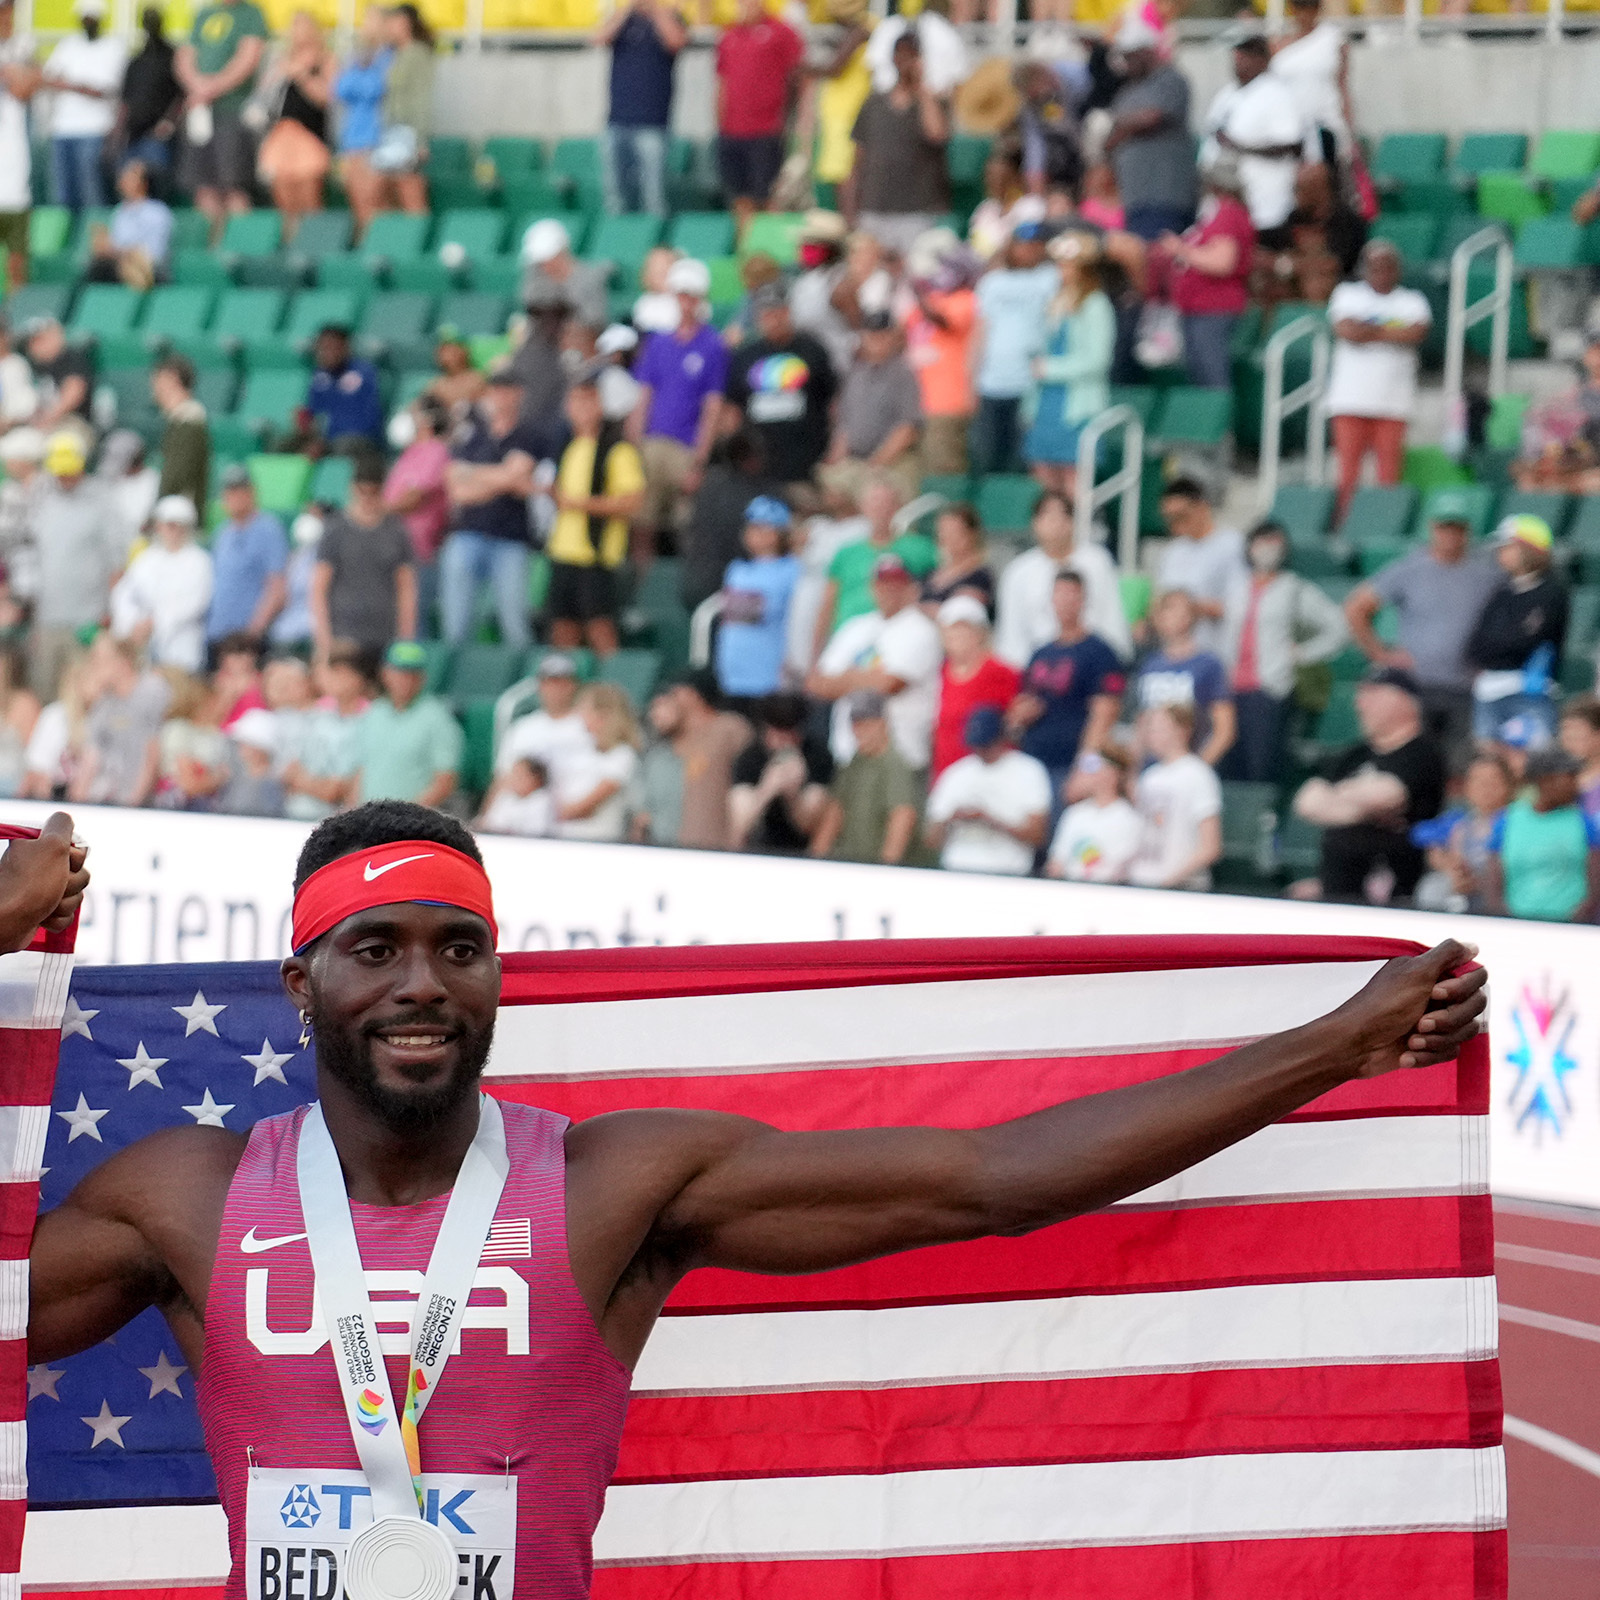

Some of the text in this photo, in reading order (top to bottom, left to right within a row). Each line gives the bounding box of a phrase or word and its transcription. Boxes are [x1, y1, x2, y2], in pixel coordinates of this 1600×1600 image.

[246, 1266, 529, 1355] USA
[414, 1293, 439, 1361] WORLD ATHLETICS
[419, 1295, 447, 1364] CHAMPIONSHIPS
[337, 1317, 358, 1386] WORLD ATHLETICS
[344, 1315, 366, 1384] CHAMPIONSHIPS
[321, 1484, 477, 1534] TK
